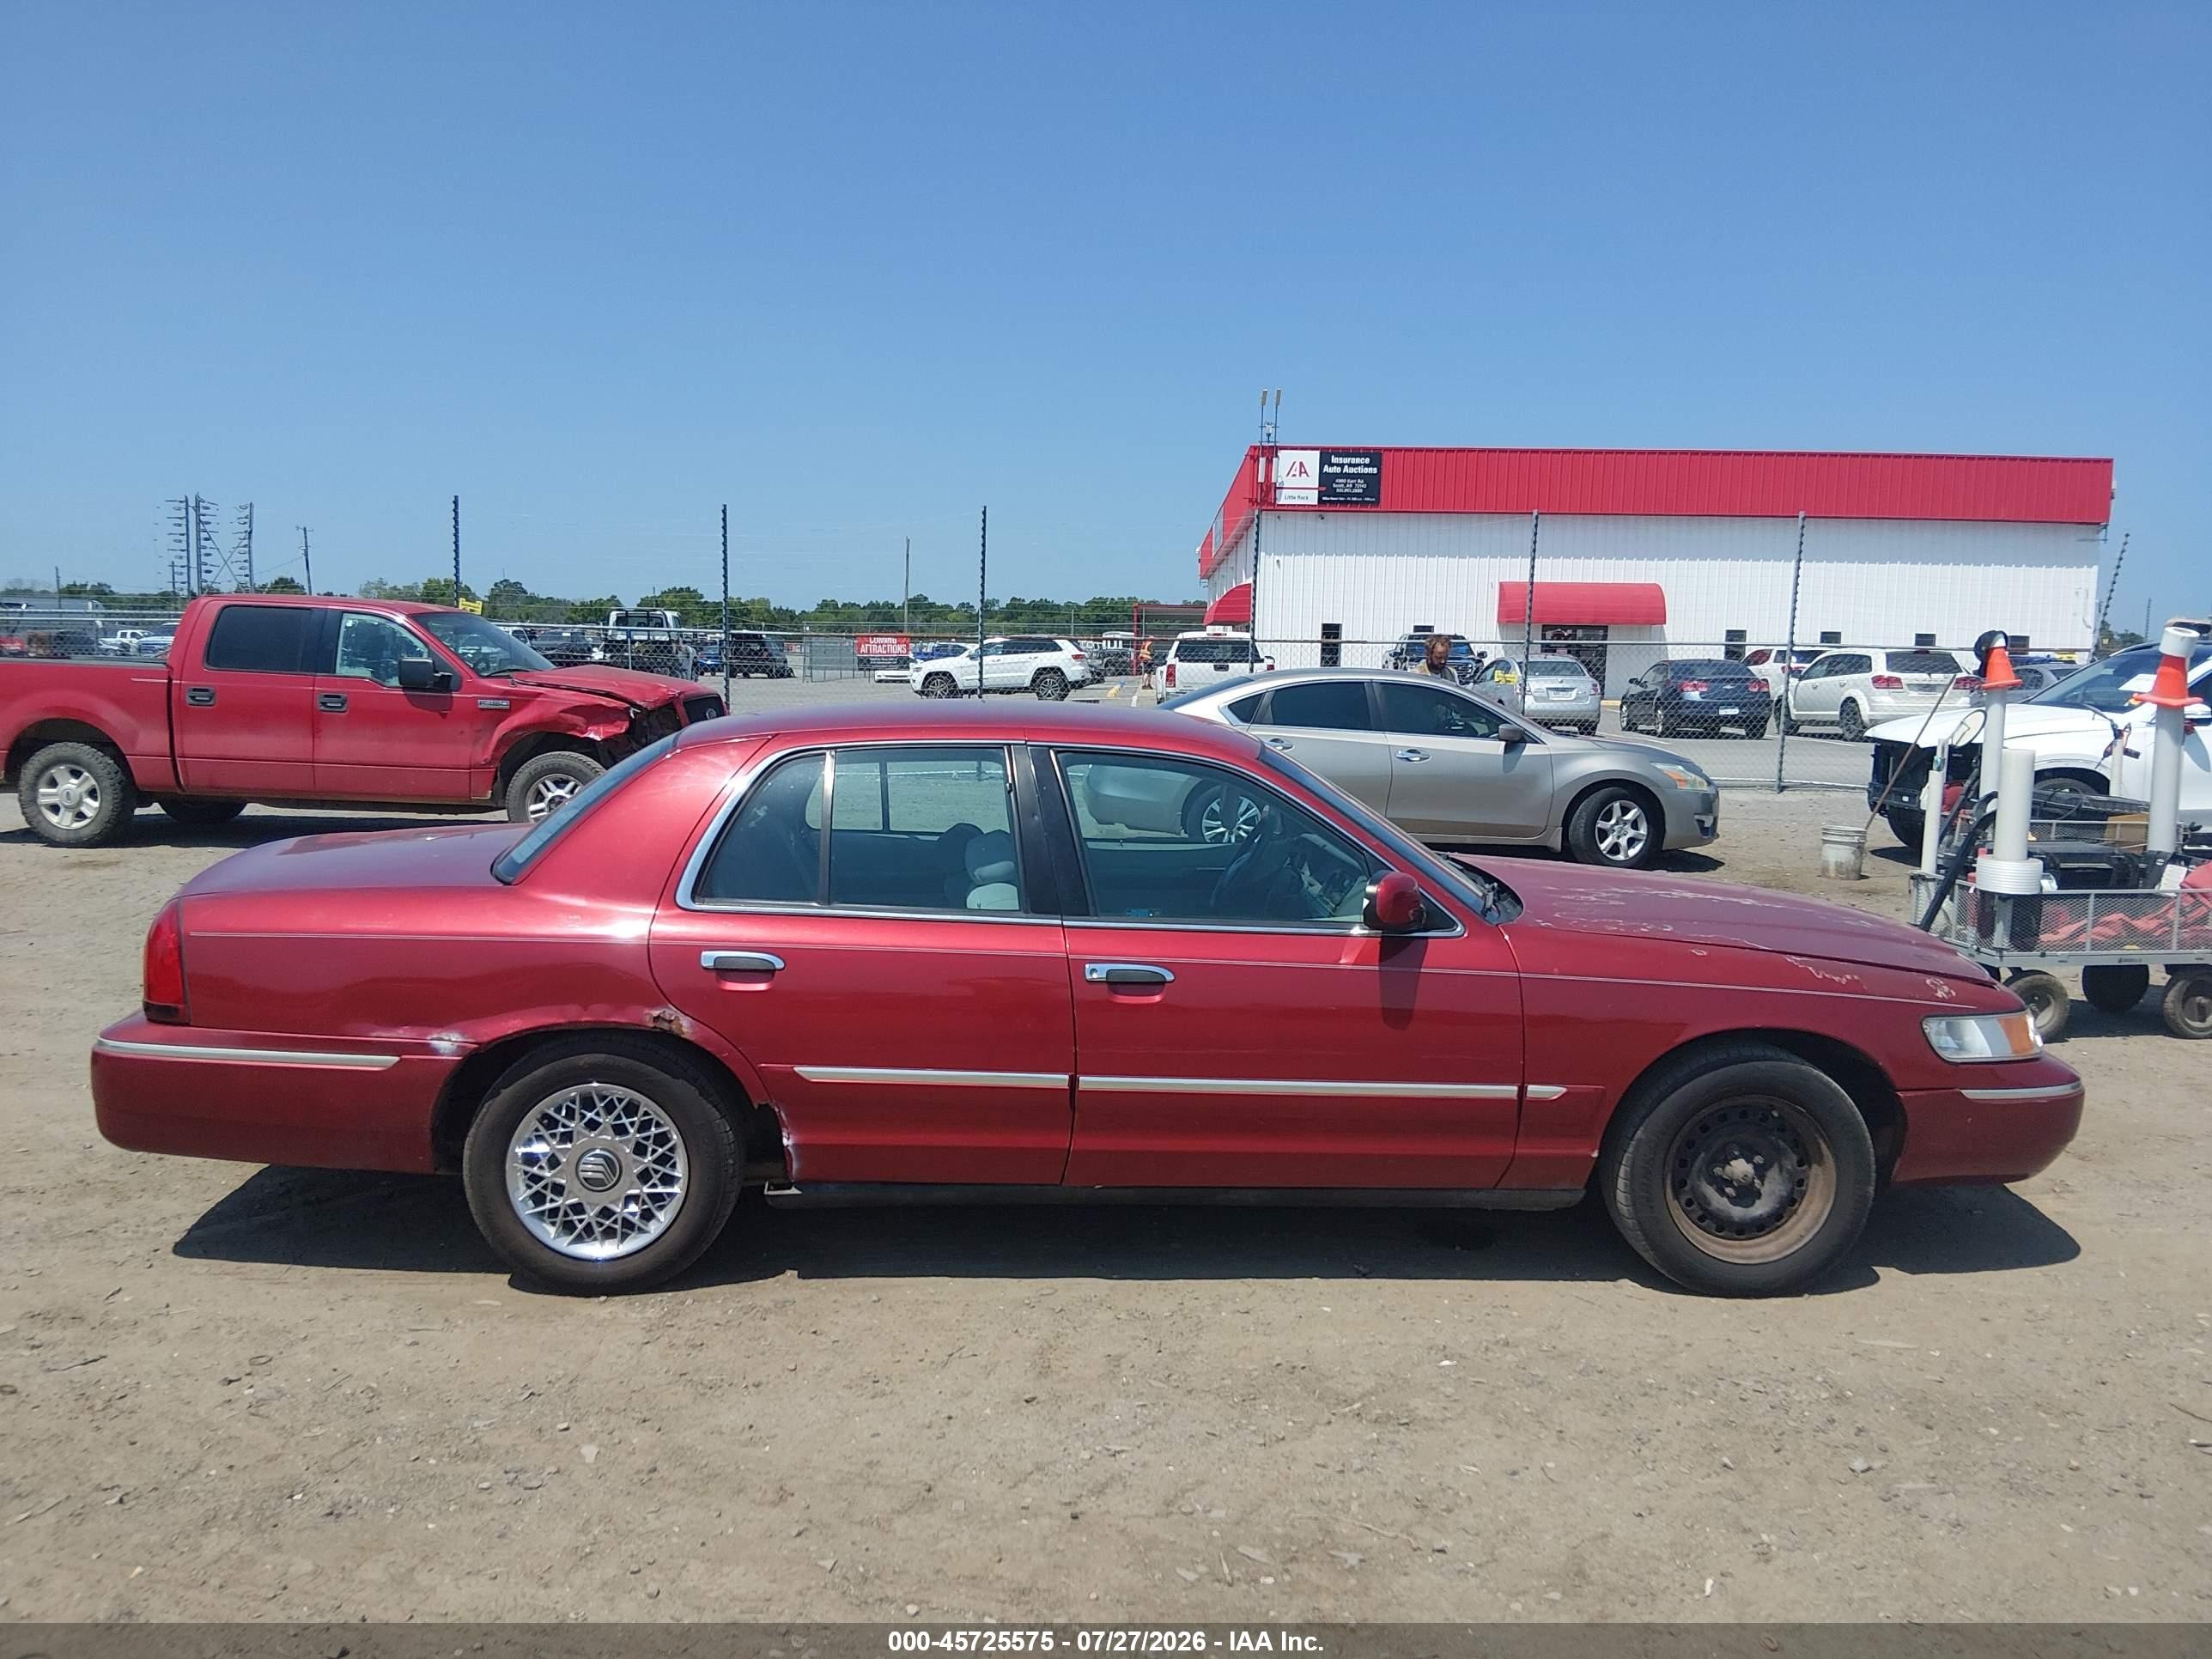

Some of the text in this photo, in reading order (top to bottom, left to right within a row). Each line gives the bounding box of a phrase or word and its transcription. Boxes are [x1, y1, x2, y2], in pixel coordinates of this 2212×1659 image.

[1331, 455, 1370, 464] Insurance
[1323, 465, 1378, 474] Auto Auctions
[860, 644, 907, 653] ATTRACTIONS
